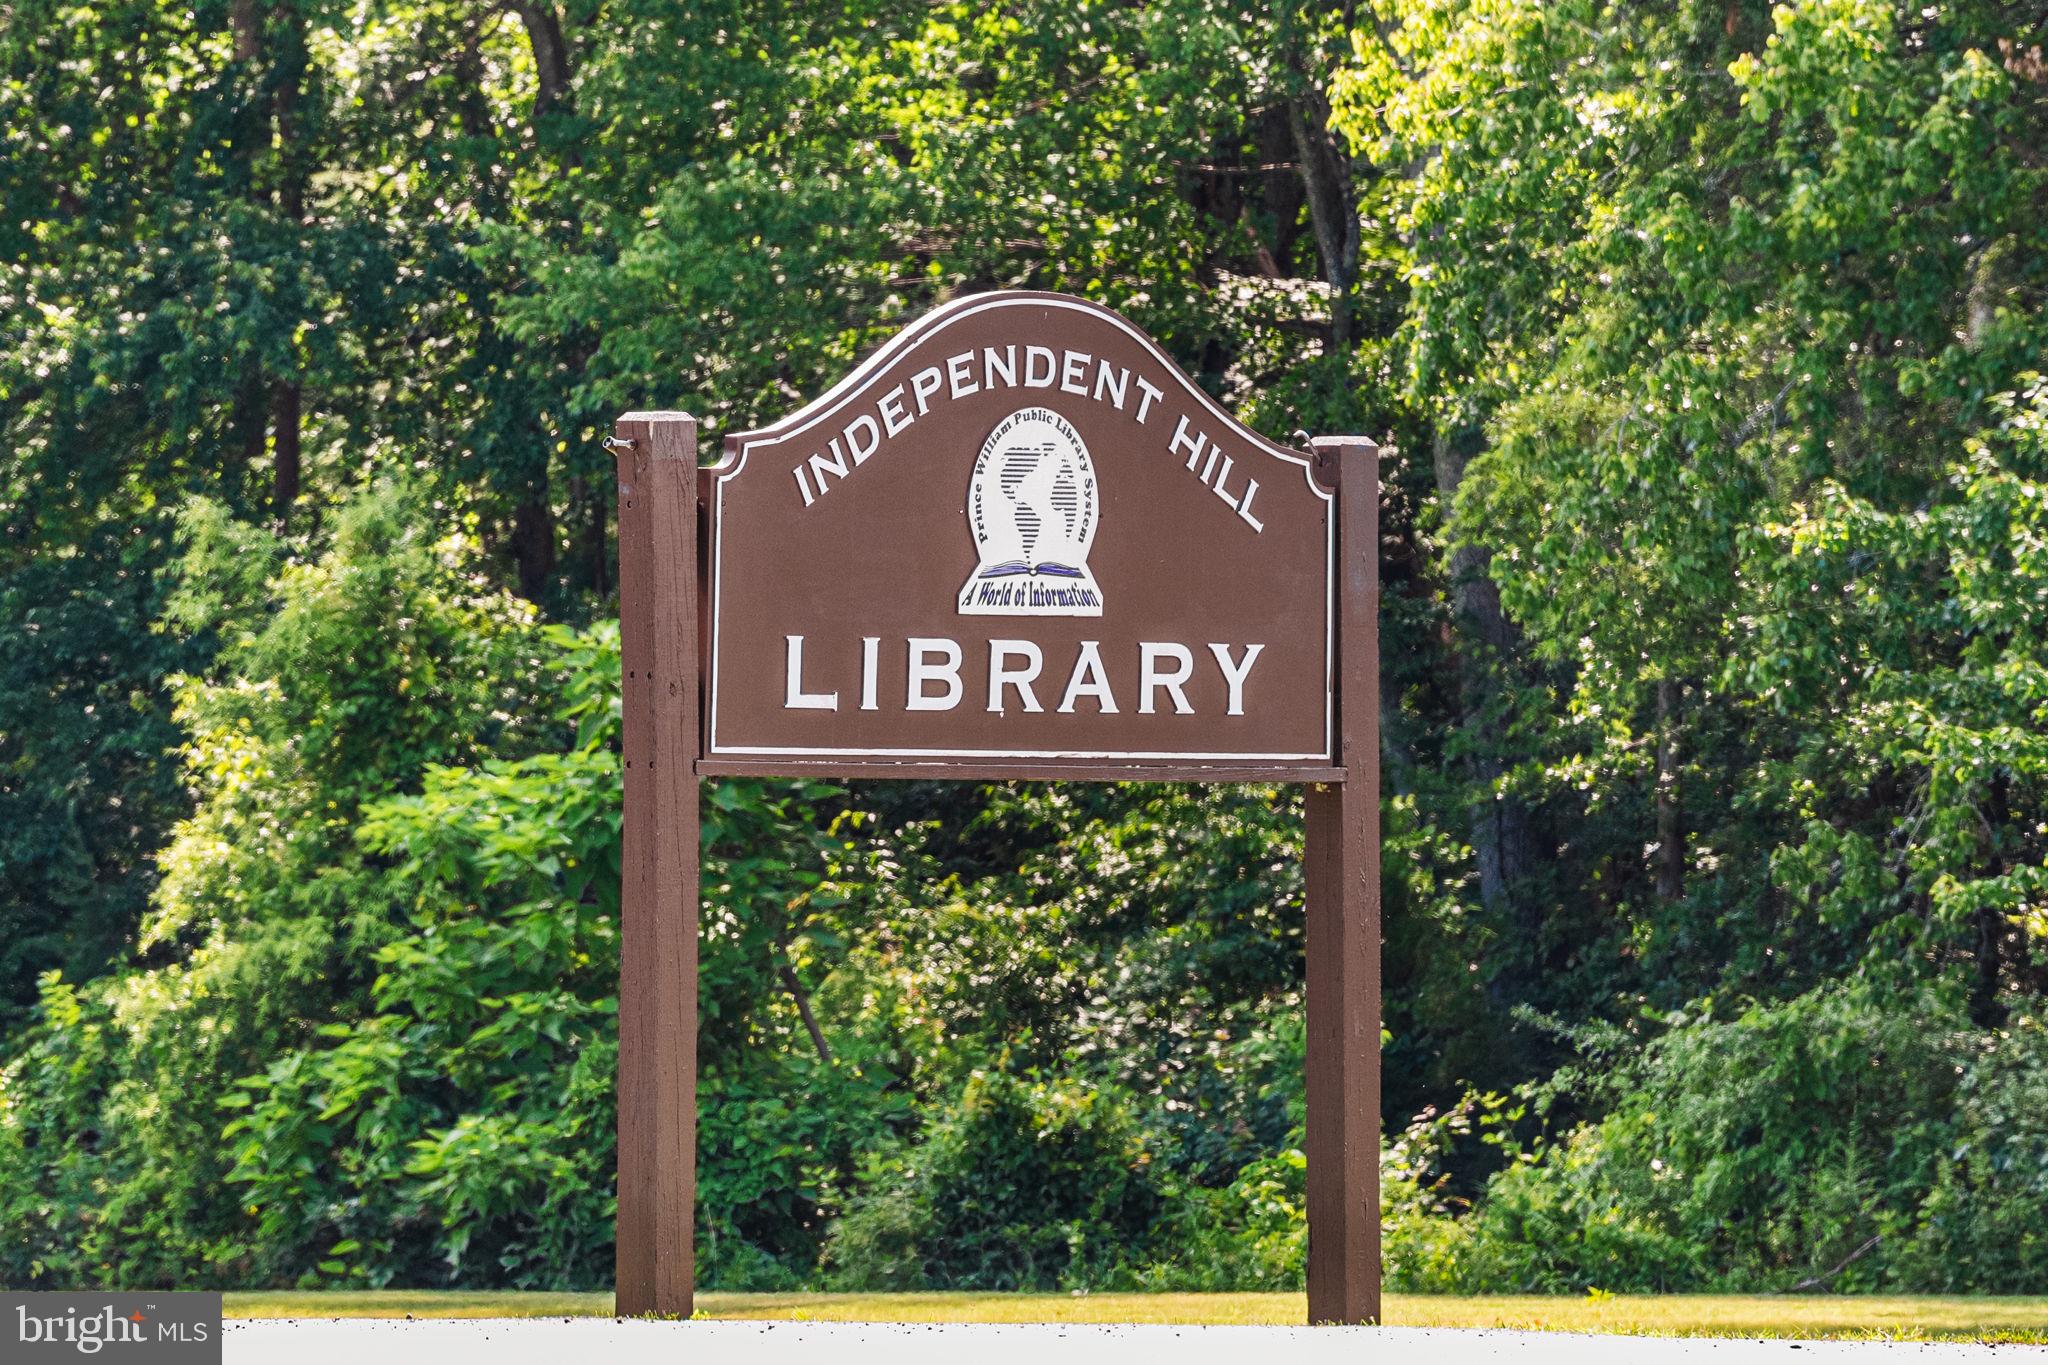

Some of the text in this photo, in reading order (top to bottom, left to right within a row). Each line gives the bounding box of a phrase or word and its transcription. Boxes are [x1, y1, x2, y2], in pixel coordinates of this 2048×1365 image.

[792, 345, 1265, 534] INDEPENDENT HILL
[974, 409, 1094, 544] Prince William Public Library System
[961, 580, 1100, 607] A World of Information
[784, 635, 1265, 716] LIBRARY
